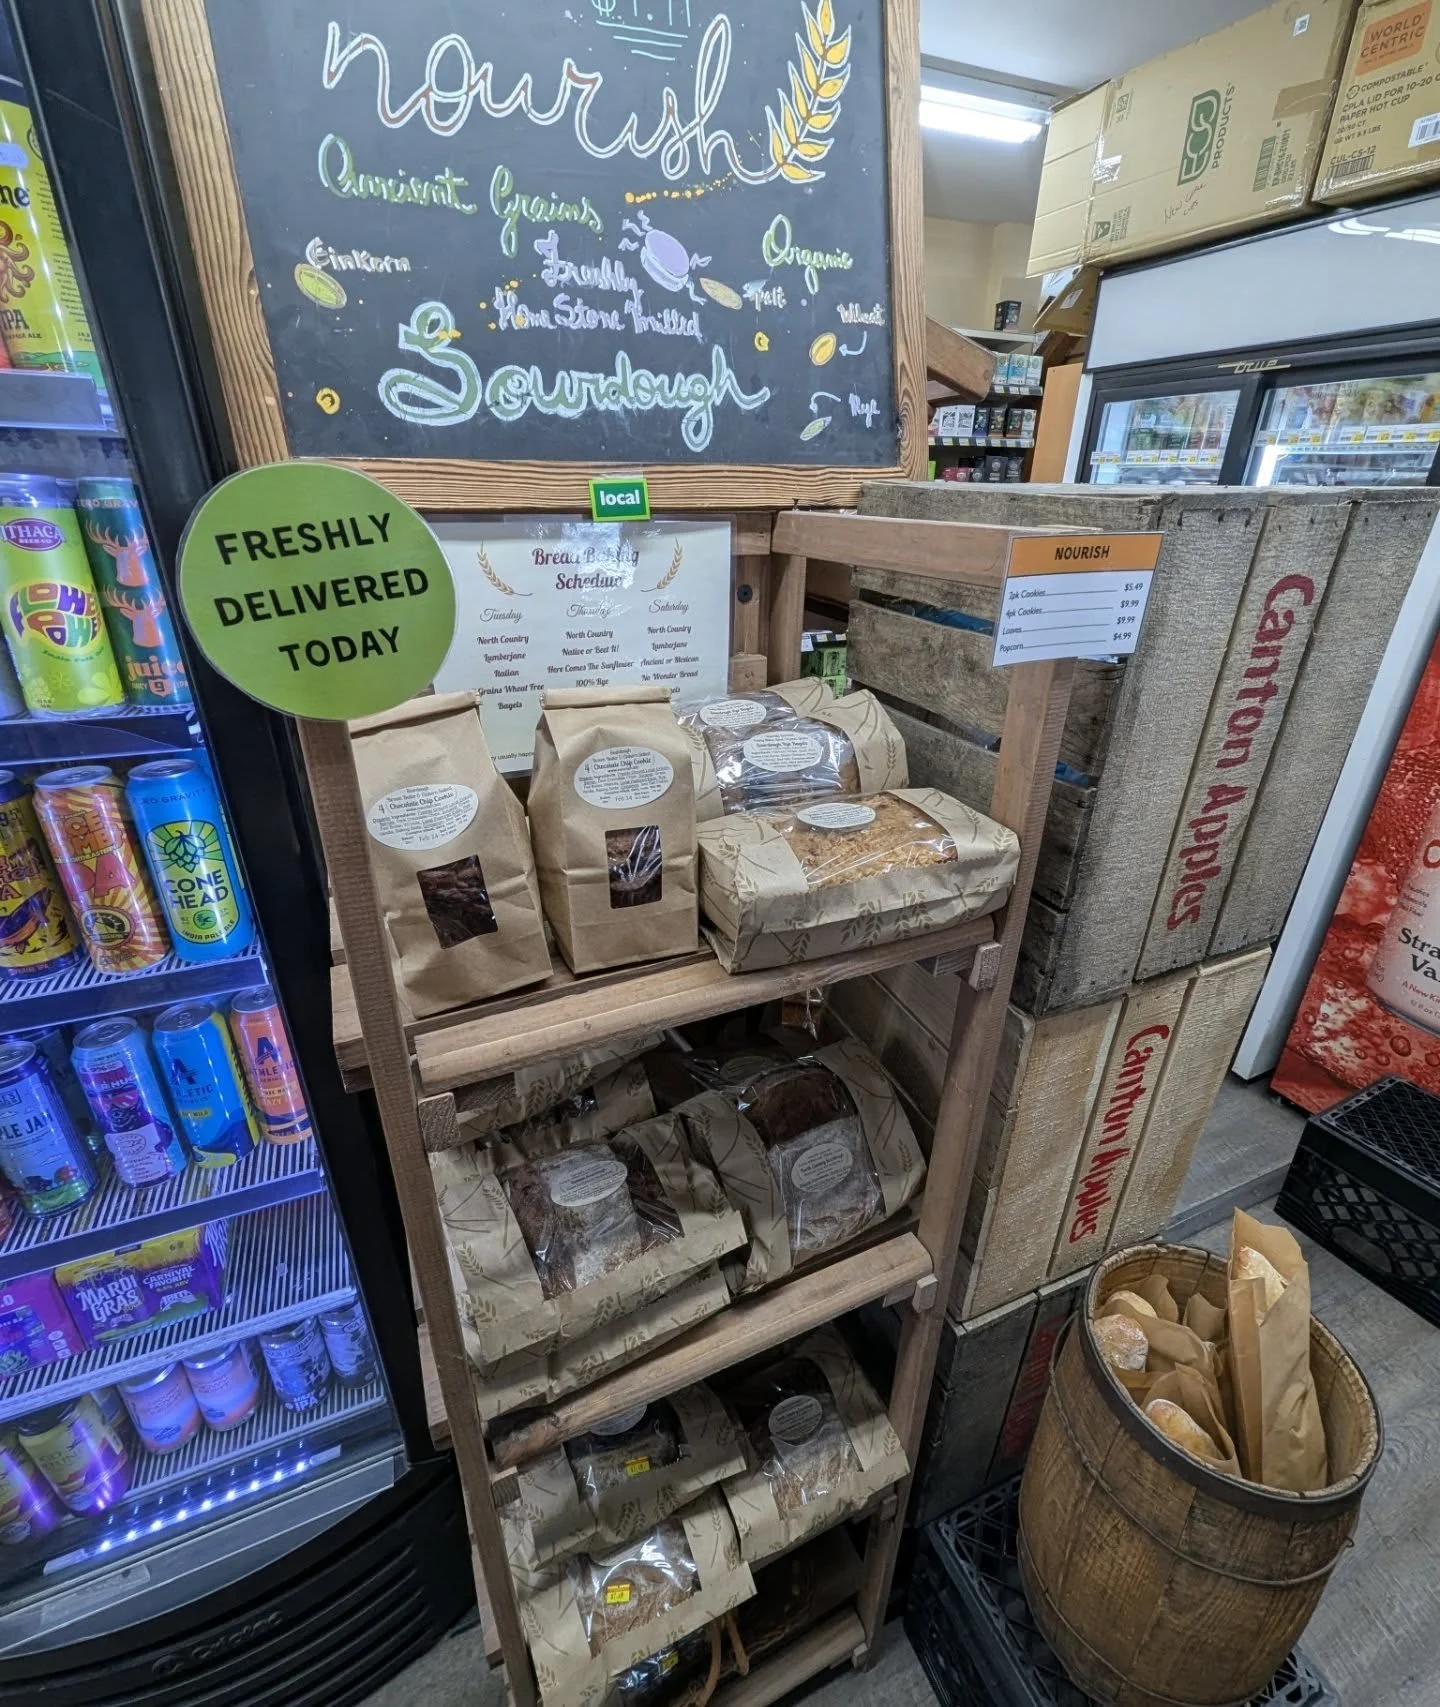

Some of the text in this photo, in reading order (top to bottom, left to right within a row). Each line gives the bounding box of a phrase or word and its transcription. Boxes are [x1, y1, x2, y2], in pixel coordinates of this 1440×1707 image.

[1371, 14, 1421, 41] WORLD
[1361, 26, 1425, 57] CENTRIC
[322, 14, 784, 184] nourish
[1367, 94, 1382, 105] LID
[1384, 86, 1403, 99] FOR
[1406, 77, 1433, 91] 10-20
[1340, 94, 1410, 122] PAPER HOT CUP
[1211, 84, 1236, 169] PRODUCTS
[490, 164, 604, 258] Grains
[762, 214, 853, 295] Organic
[494, 286, 557, 331] Home
[553, 292, 625, 331] Stone
[378, 301, 770, 451] Sourdough
[600, 489, 641, 507] local
[215, 513, 391, 565] FRESHLY
[1055, 545, 1110, 560] NOURISH
[214, 568, 429, 627] DELIVERED
[1021, 589, 1046, 599] Cookies
[1124, 582, 1143, 592] $5.49
[479, 608, 524, 624] Tuesday
[649, 599, 689, 615] Saturday
[1018, 607, 1042, 617] Cookies
[1120, 600, 1139, 609] $9.99
[647, 625, 692, 634] North Country
[1117, 616, 1135, 625] $9.99
[477, 634, 529, 645] North Country
[565, 629, 614, 640] North Country
[1000, 632, 1132, 653] Popcorn $4.99
[278, 626, 400, 672] TODAY
[484, 652, 527, 663] Lumberjane
[562, 647, 584, 656] Native
[494, 669, 519, 677] Italian
[547, 660, 634, 674] Here Comes The Sunflower
[504, 684, 528, 693] Wheat
[575, 678, 595, 687] 100%
[498, 701, 522, 711] Bagels
[1167, 574, 1315, 929] Canton Apples
[594, 762, 619, 770] Chocolate
[390, 801, 419, 810] Chocolate
[164, 869, 225, 894] CONE
[170, 886, 229, 909] HEAD
[1069, 1023, 1170, 1244] Canton Apples
[143, 1265, 195, 1285] CARNIVAL
[149, 1273, 193, 1289] FAVORITE
[76, 1275, 138, 1312] MARDI
[90, 1290, 140, 1323] GRAS
